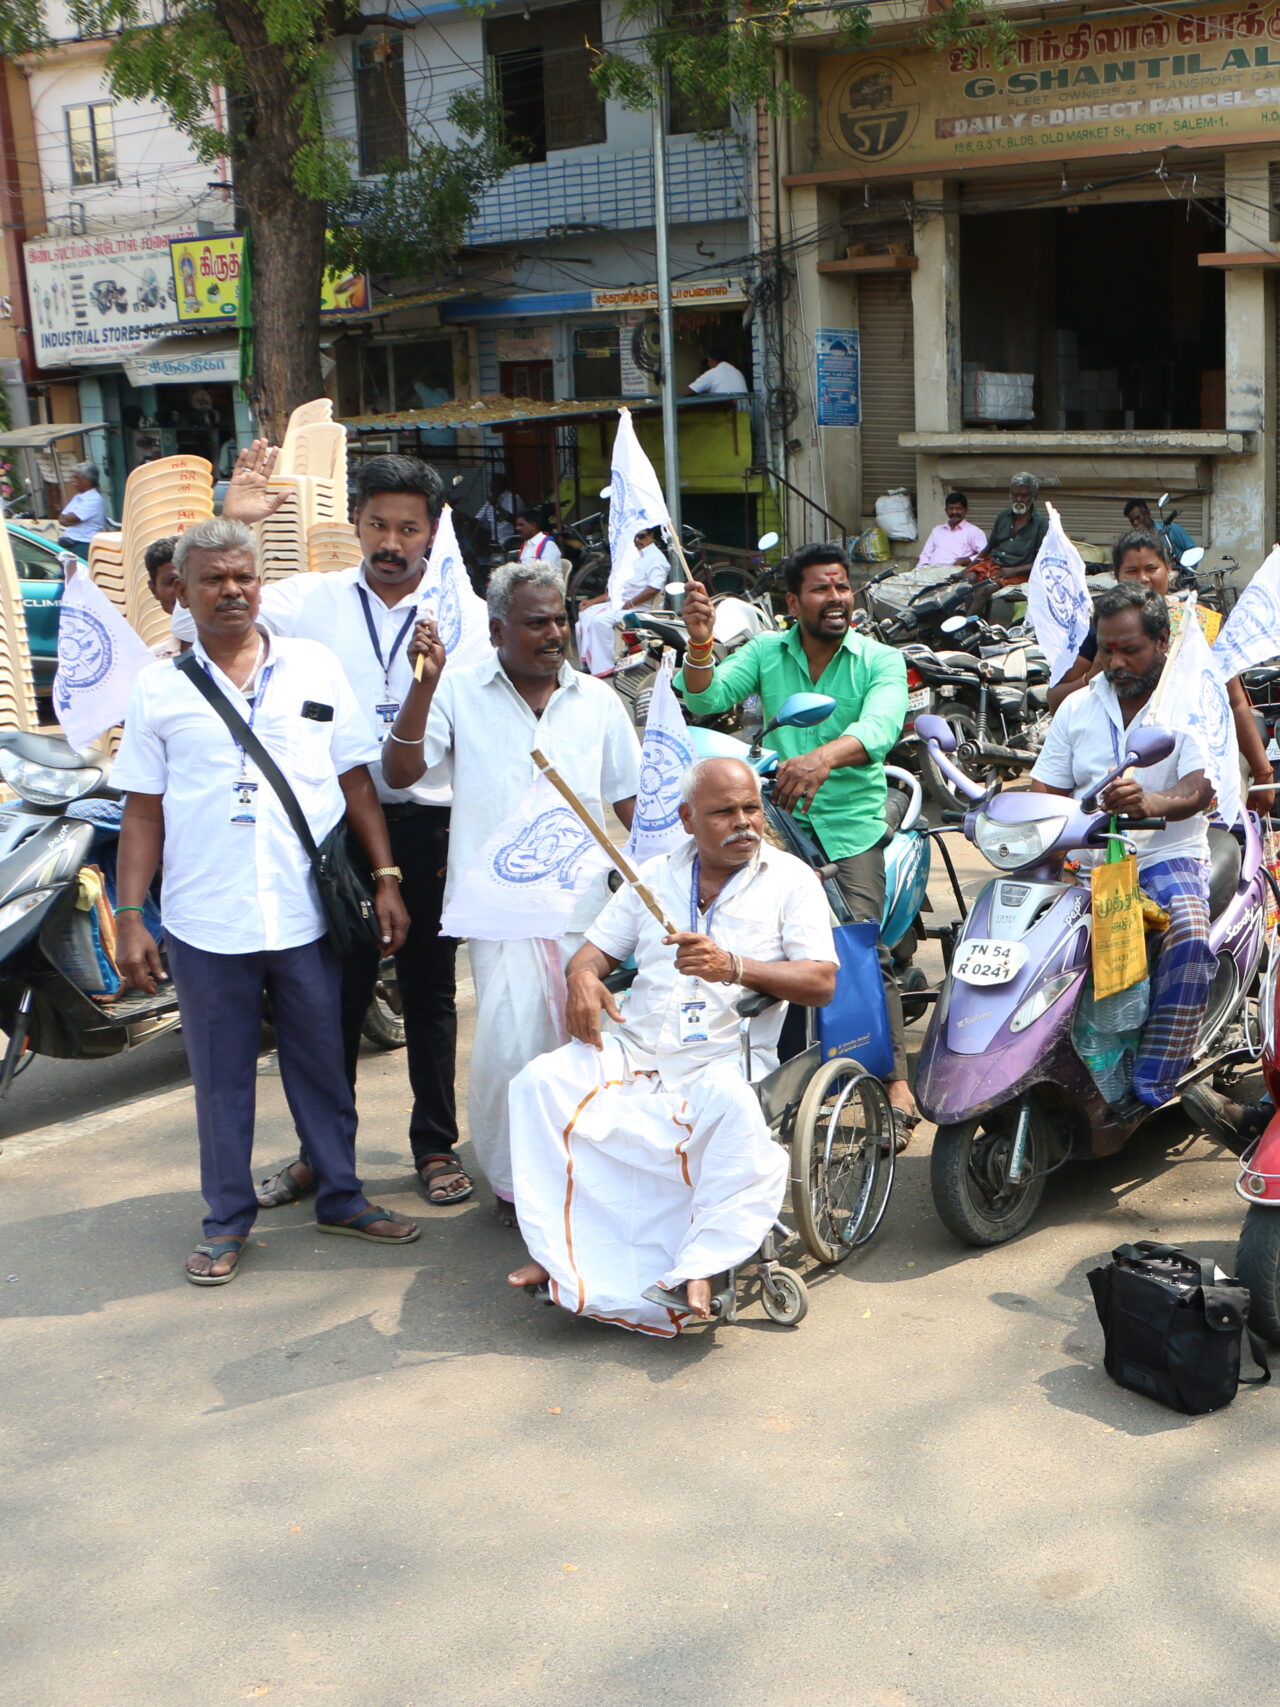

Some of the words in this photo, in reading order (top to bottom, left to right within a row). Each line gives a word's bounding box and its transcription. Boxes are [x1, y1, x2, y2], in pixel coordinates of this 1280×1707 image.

[1007, 94, 1048, 108] FLEET
[1058, 86, 1121, 103] OWNERS
[1128, 85, 1138, 95] &
[1146, 73, 1244, 92] TRANSPORT
[954, 112, 1028, 135] DAILY
[1031, 113, 1046, 126] &
[1049, 99, 1143, 126] DIRECT
[1150, 90, 1250, 116] PARCEL
[1041, 132, 1065, 145] OLD
[1066, 127, 1109, 142] MARKET
[1135, 121, 1169, 136] FORT,
[41, 329, 101, 348] INDUSTRIAL
[102, 325, 141, 344] STORES
[970, 944, 989, 956] TN
[992, 946, 1011, 958] 54
[957, 963, 969, 975] R
[971, 963, 1011, 979] 0241
